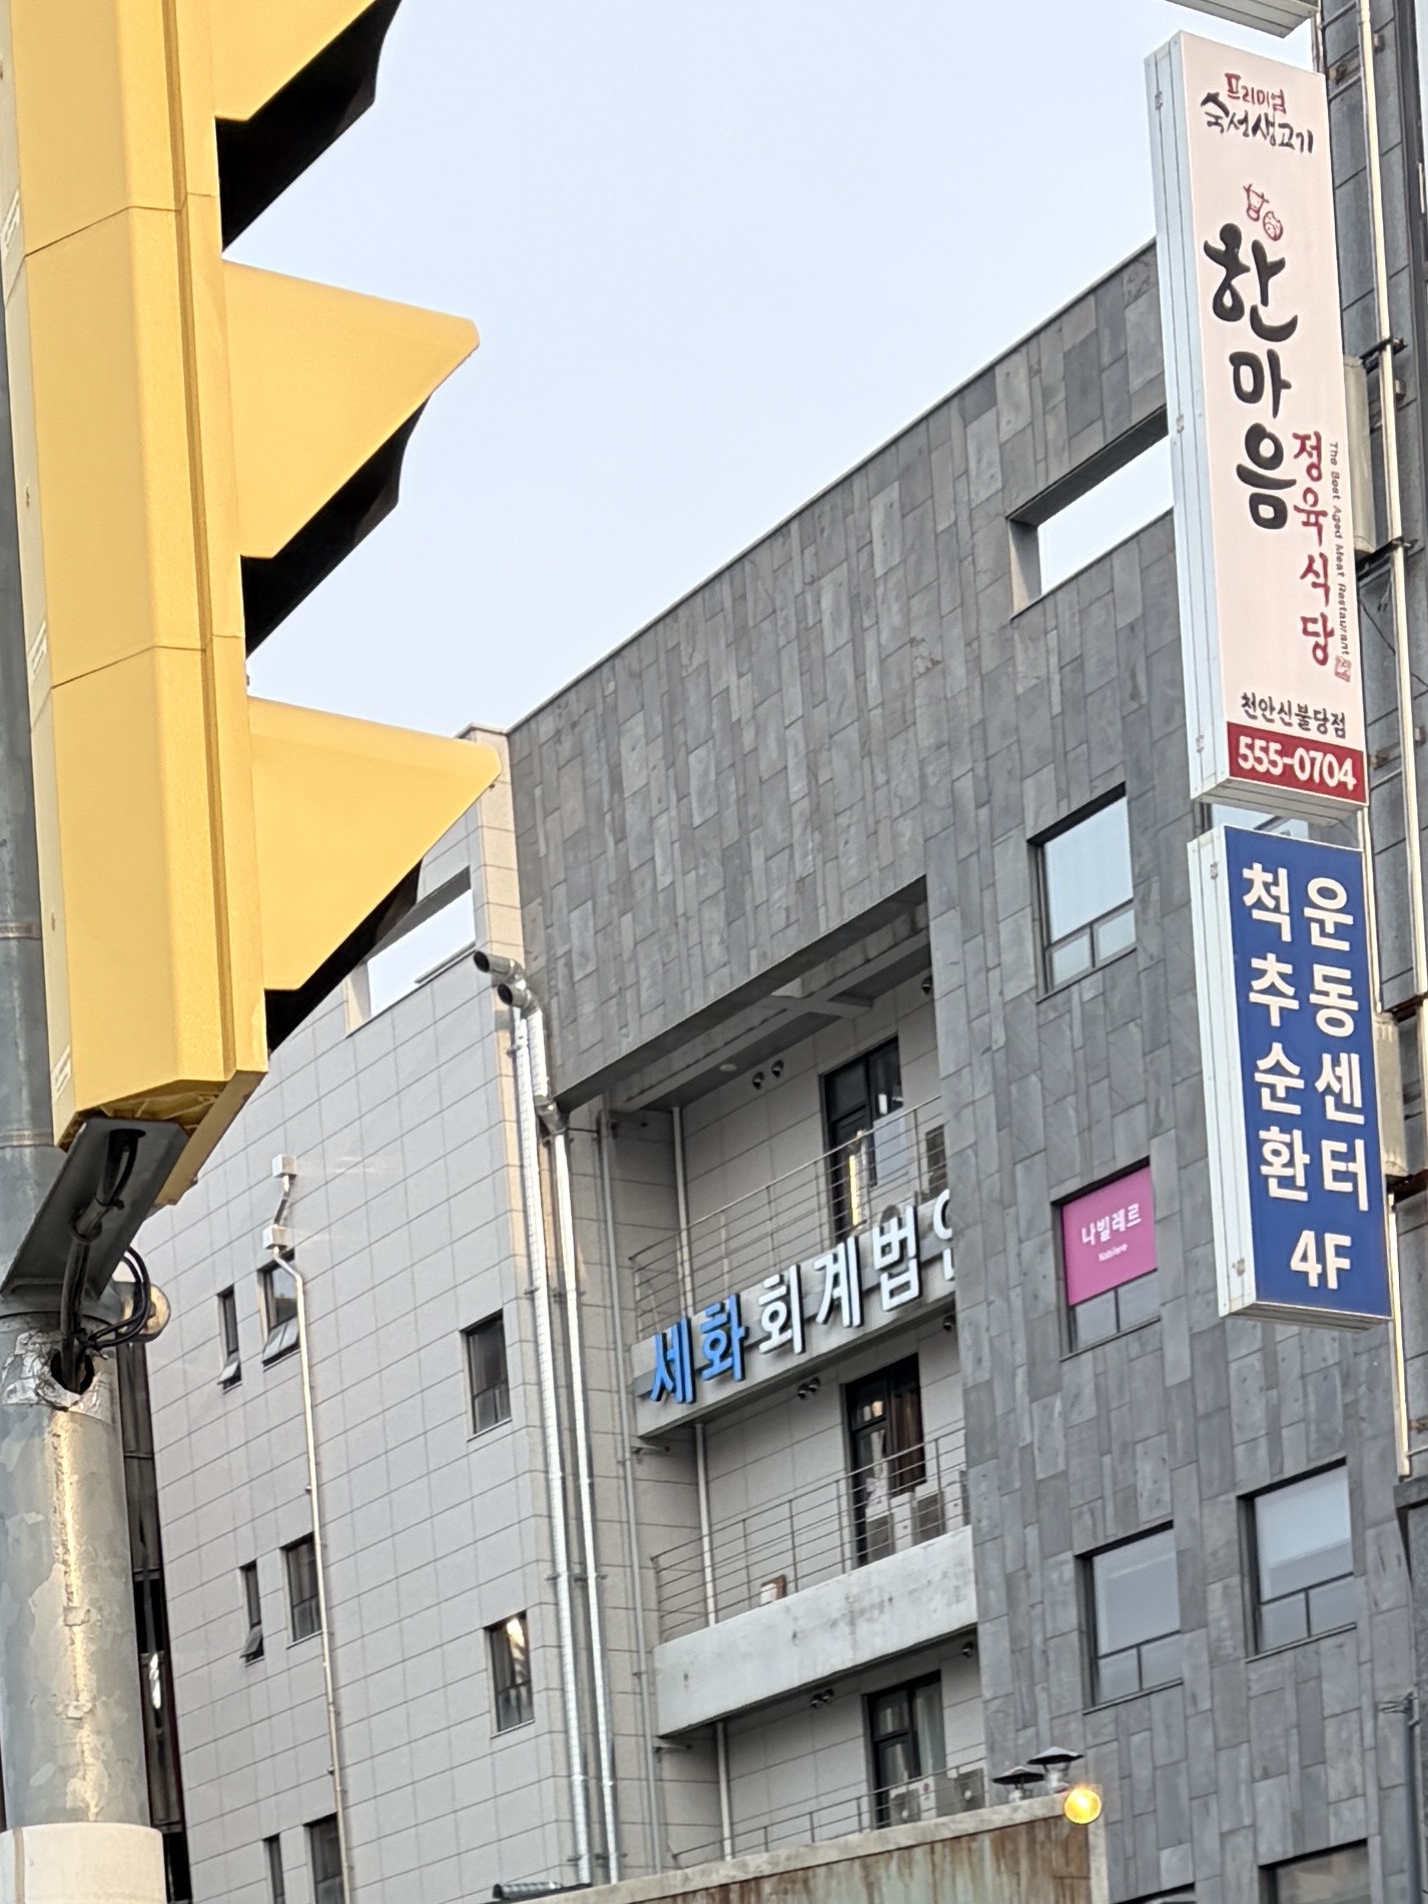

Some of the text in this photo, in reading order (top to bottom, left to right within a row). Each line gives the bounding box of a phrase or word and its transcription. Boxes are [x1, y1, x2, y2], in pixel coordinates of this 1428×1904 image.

[1224, 73, 1287, 115] 프리미엄
[1203, 222, 1299, 531] 한마음
[1292, 430, 1336, 667] 정육식당
[1237, 734, 1357, 791] 555-0704
[1240, 691, 1347, 739] 천안신불당점
[1242, 860, 1312, 1204] 척추순환
[1303, 875, 1370, 1213] 운동센터
[1290, 1229, 1352, 1290] 4F
